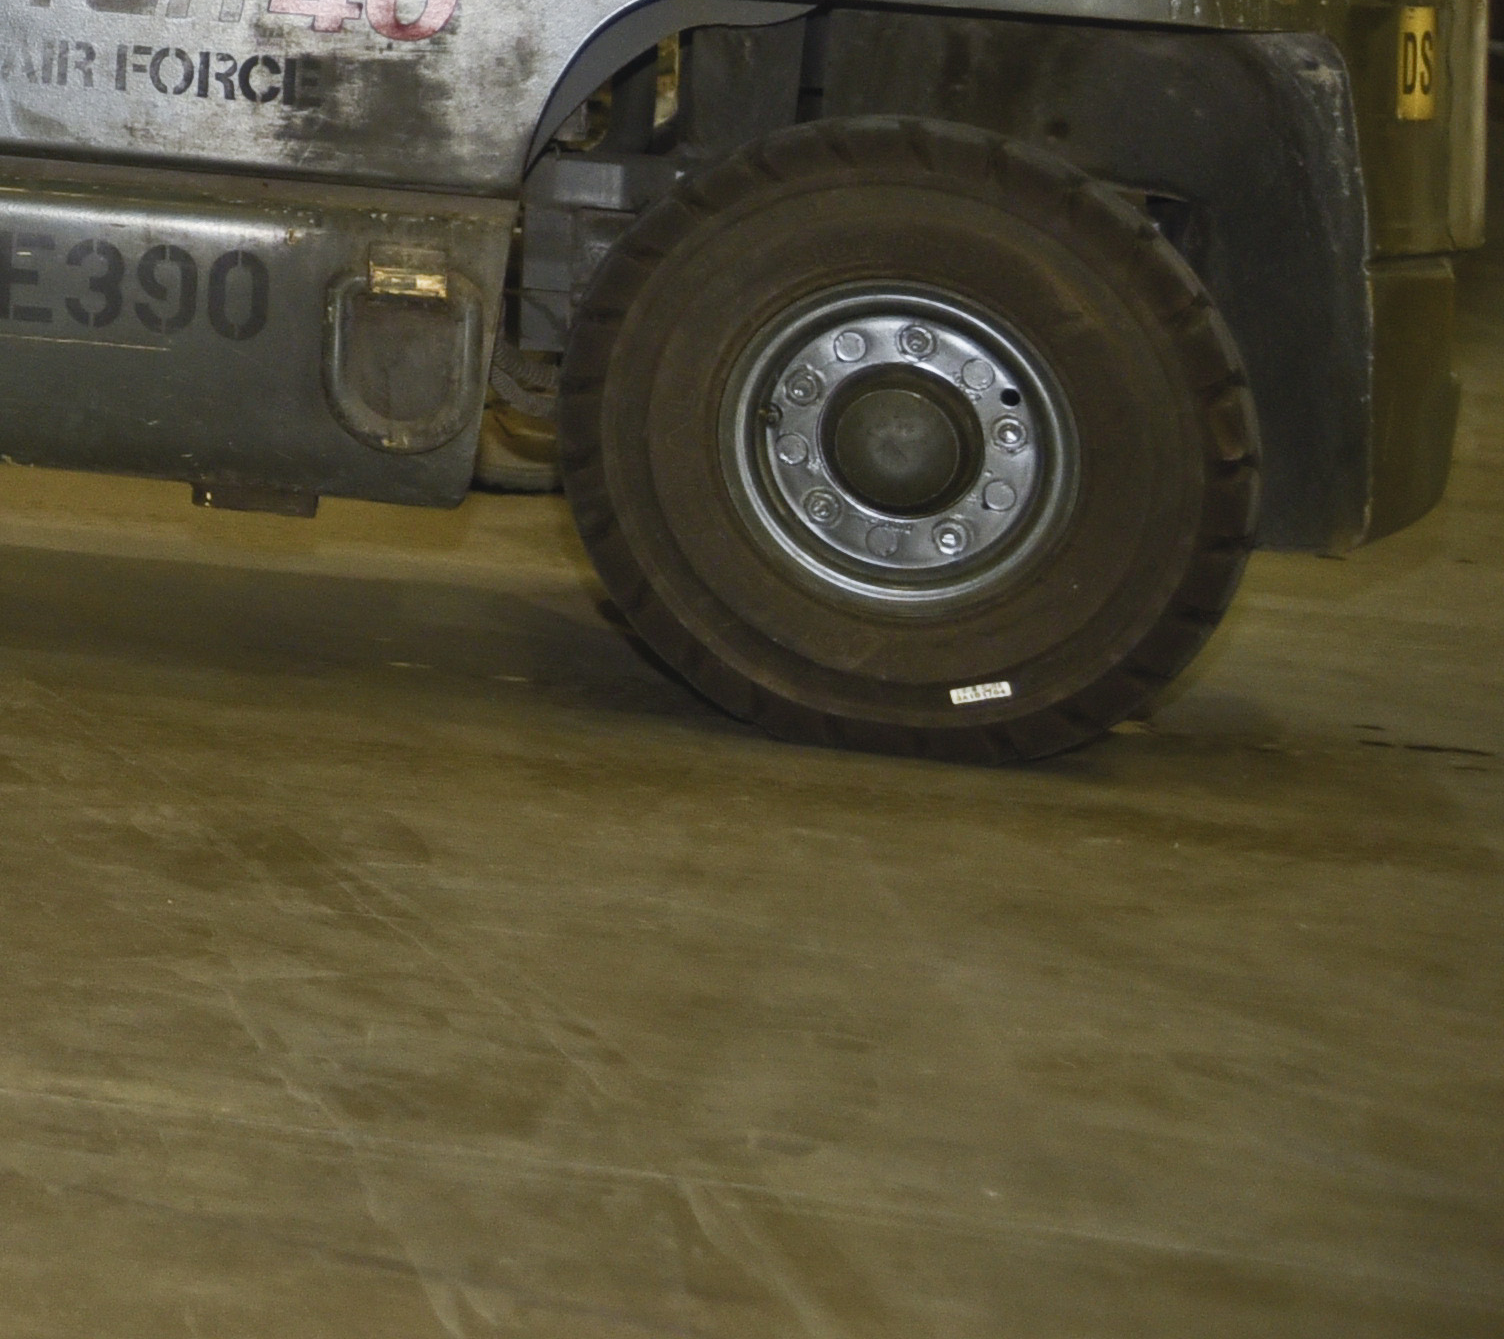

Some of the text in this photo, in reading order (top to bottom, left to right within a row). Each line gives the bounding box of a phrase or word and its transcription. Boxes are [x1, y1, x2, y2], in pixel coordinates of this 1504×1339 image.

[0, 35, 97, 89] AIR
[114, 44, 326, 107] FORCE
[1402, 31, 1434, 95] DS
